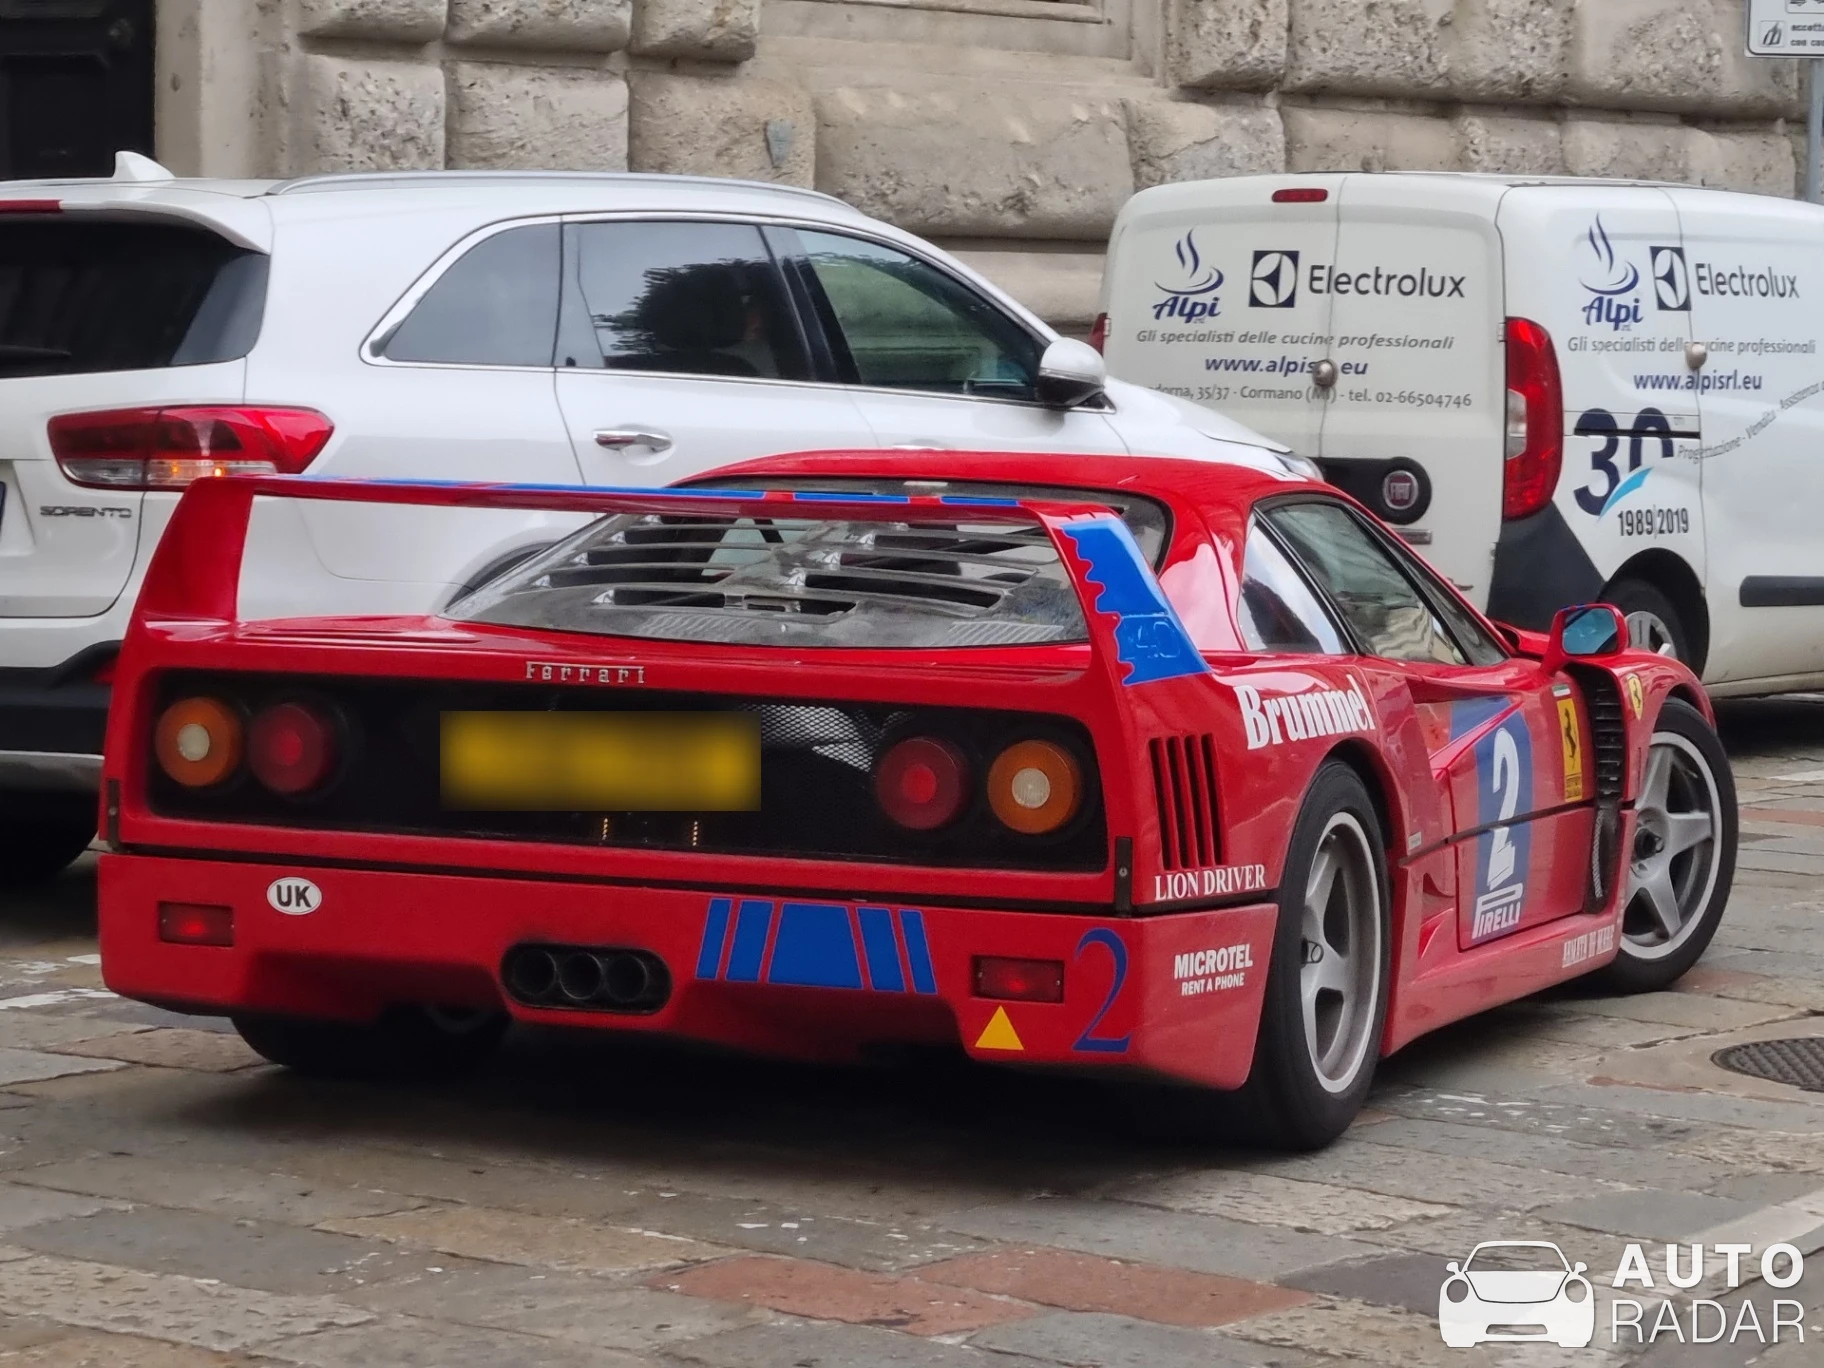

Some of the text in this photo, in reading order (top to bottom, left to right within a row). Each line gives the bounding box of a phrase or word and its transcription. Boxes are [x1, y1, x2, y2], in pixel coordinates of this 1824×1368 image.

[1308, 265, 1466, 298] Electrolux
[1695, 263, 1800, 298] Electrolux
[1152, 296, 1221, 323] Alpi
[1582, 296, 1644, 331] Alpi
[1136, 330, 1455, 349] Gli specialisti delle cucine professionali
[1568, 336, 1588, 352] Gli
[1592, 337, 1655, 356] specialisti
[1737, 339, 1817, 356] professionali
[1633, 369, 1763, 395] www.alpisrl.eu
[1197, 384, 1230, 400] 35/37
[1240, 386, 1303, 399] Cormano
[1349, 388, 1372, 402] tel.
[1376, 390, 1473, 409] 02-66504746
[40, 505, 132, 518] SORENTO
[526, 661, 645, 684] Ferrari
[1233, 673, 1376, 750] Brummel
[1487, 727, 1520, 891] 2
[276, 884, 312, 908] UK
[1154, 864, 1266, 901] LION DRIVER
[1174, 943, 1254, 980] MICROTEL
[1072, 927, 1133, 1053] 2
[1181, 972, 1245, 996] RENT A PHONE
